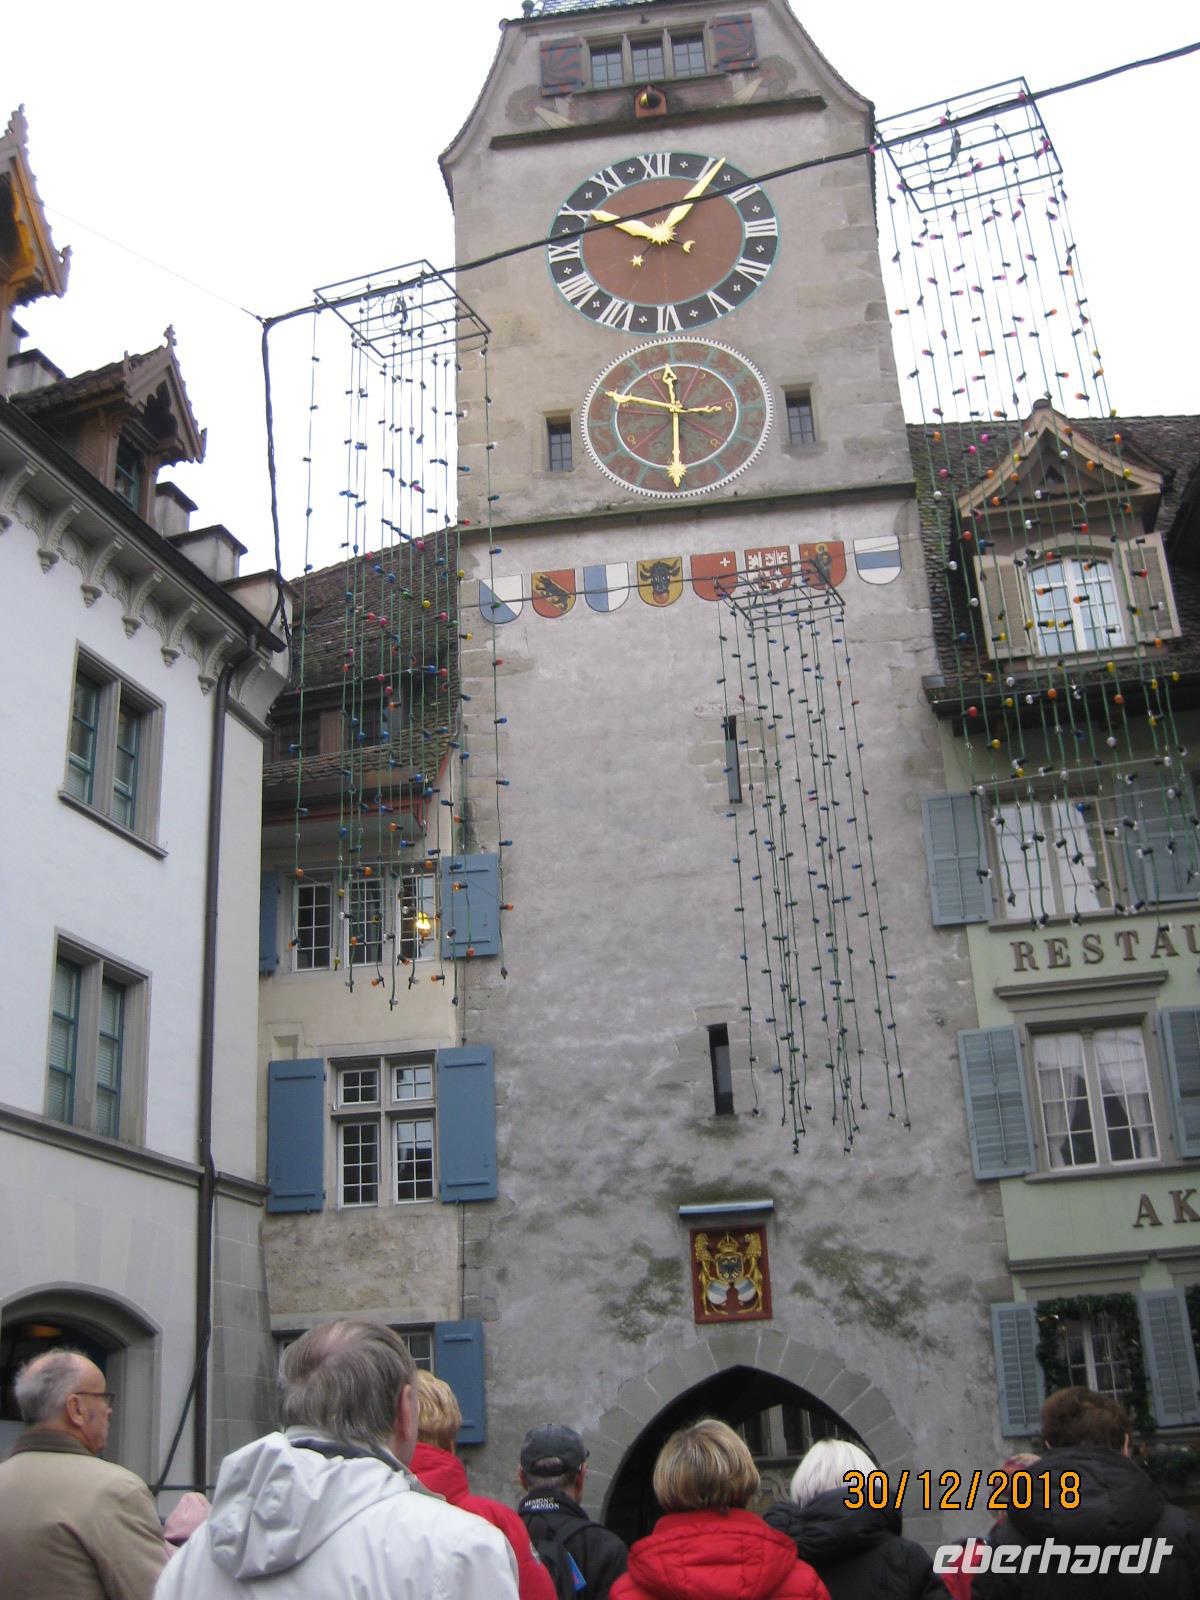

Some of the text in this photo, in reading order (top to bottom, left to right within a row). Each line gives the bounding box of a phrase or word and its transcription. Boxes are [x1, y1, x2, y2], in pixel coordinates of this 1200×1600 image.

[588, 166, 626, 196] XI
[637, 152, 672, 181] XII
[655, 303, 684, 334] VI
[706, 289, 737, 319] V
[1009, 924, 1200, 973] RESTAU
[1132, 1188, 1200, 1228] AK
